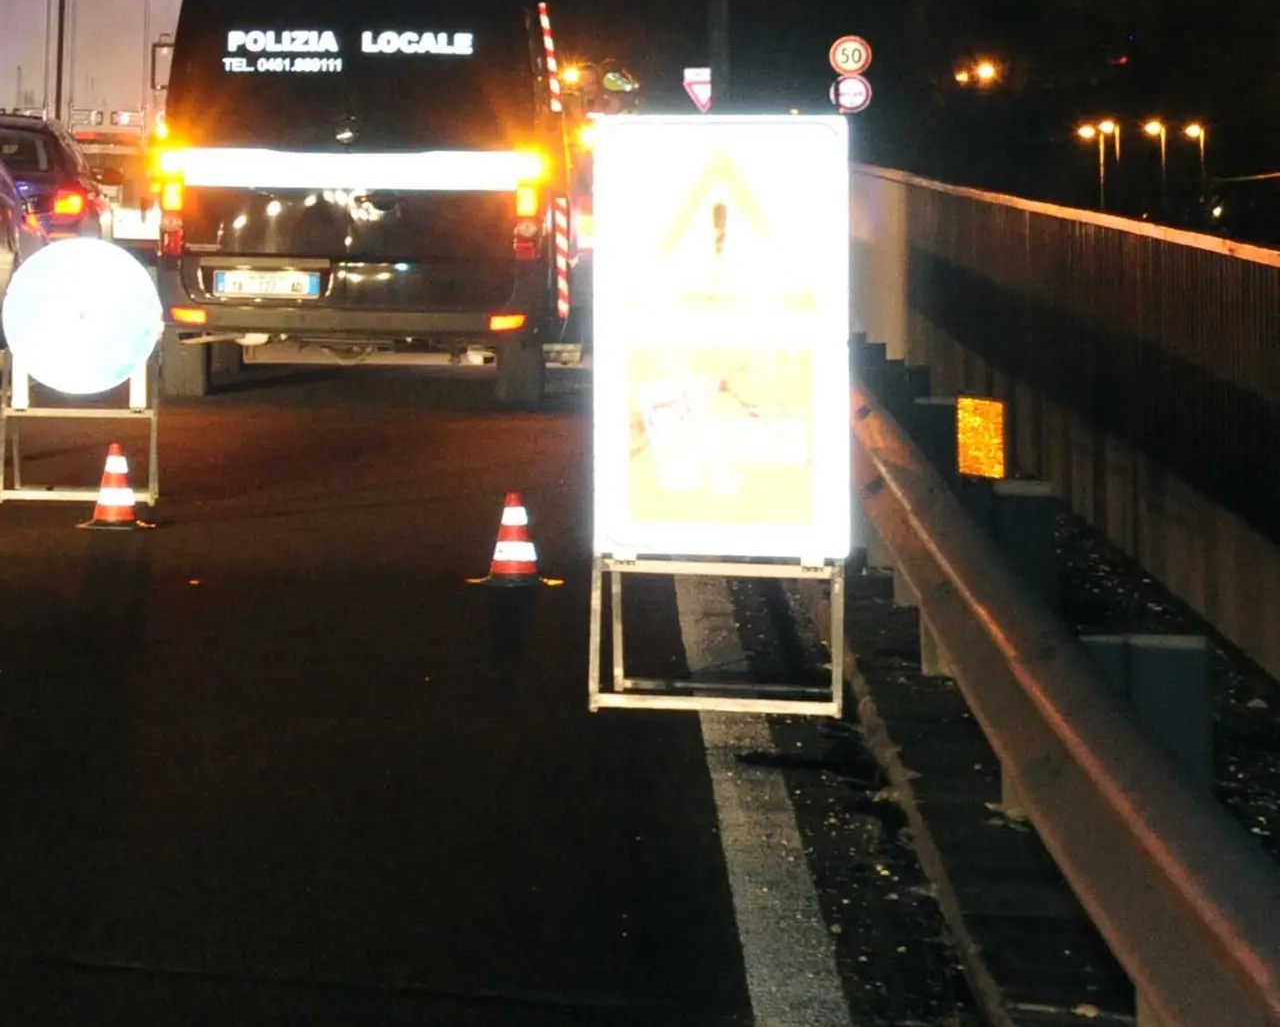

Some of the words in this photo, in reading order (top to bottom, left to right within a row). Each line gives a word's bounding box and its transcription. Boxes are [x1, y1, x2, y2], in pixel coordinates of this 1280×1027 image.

[228, 30, 339, 52] POLIZIA
[361, 31, 473, 55] LOCALE
[841, 48, 862, 64] 50
[222, 57, 254, 72] TEL.
